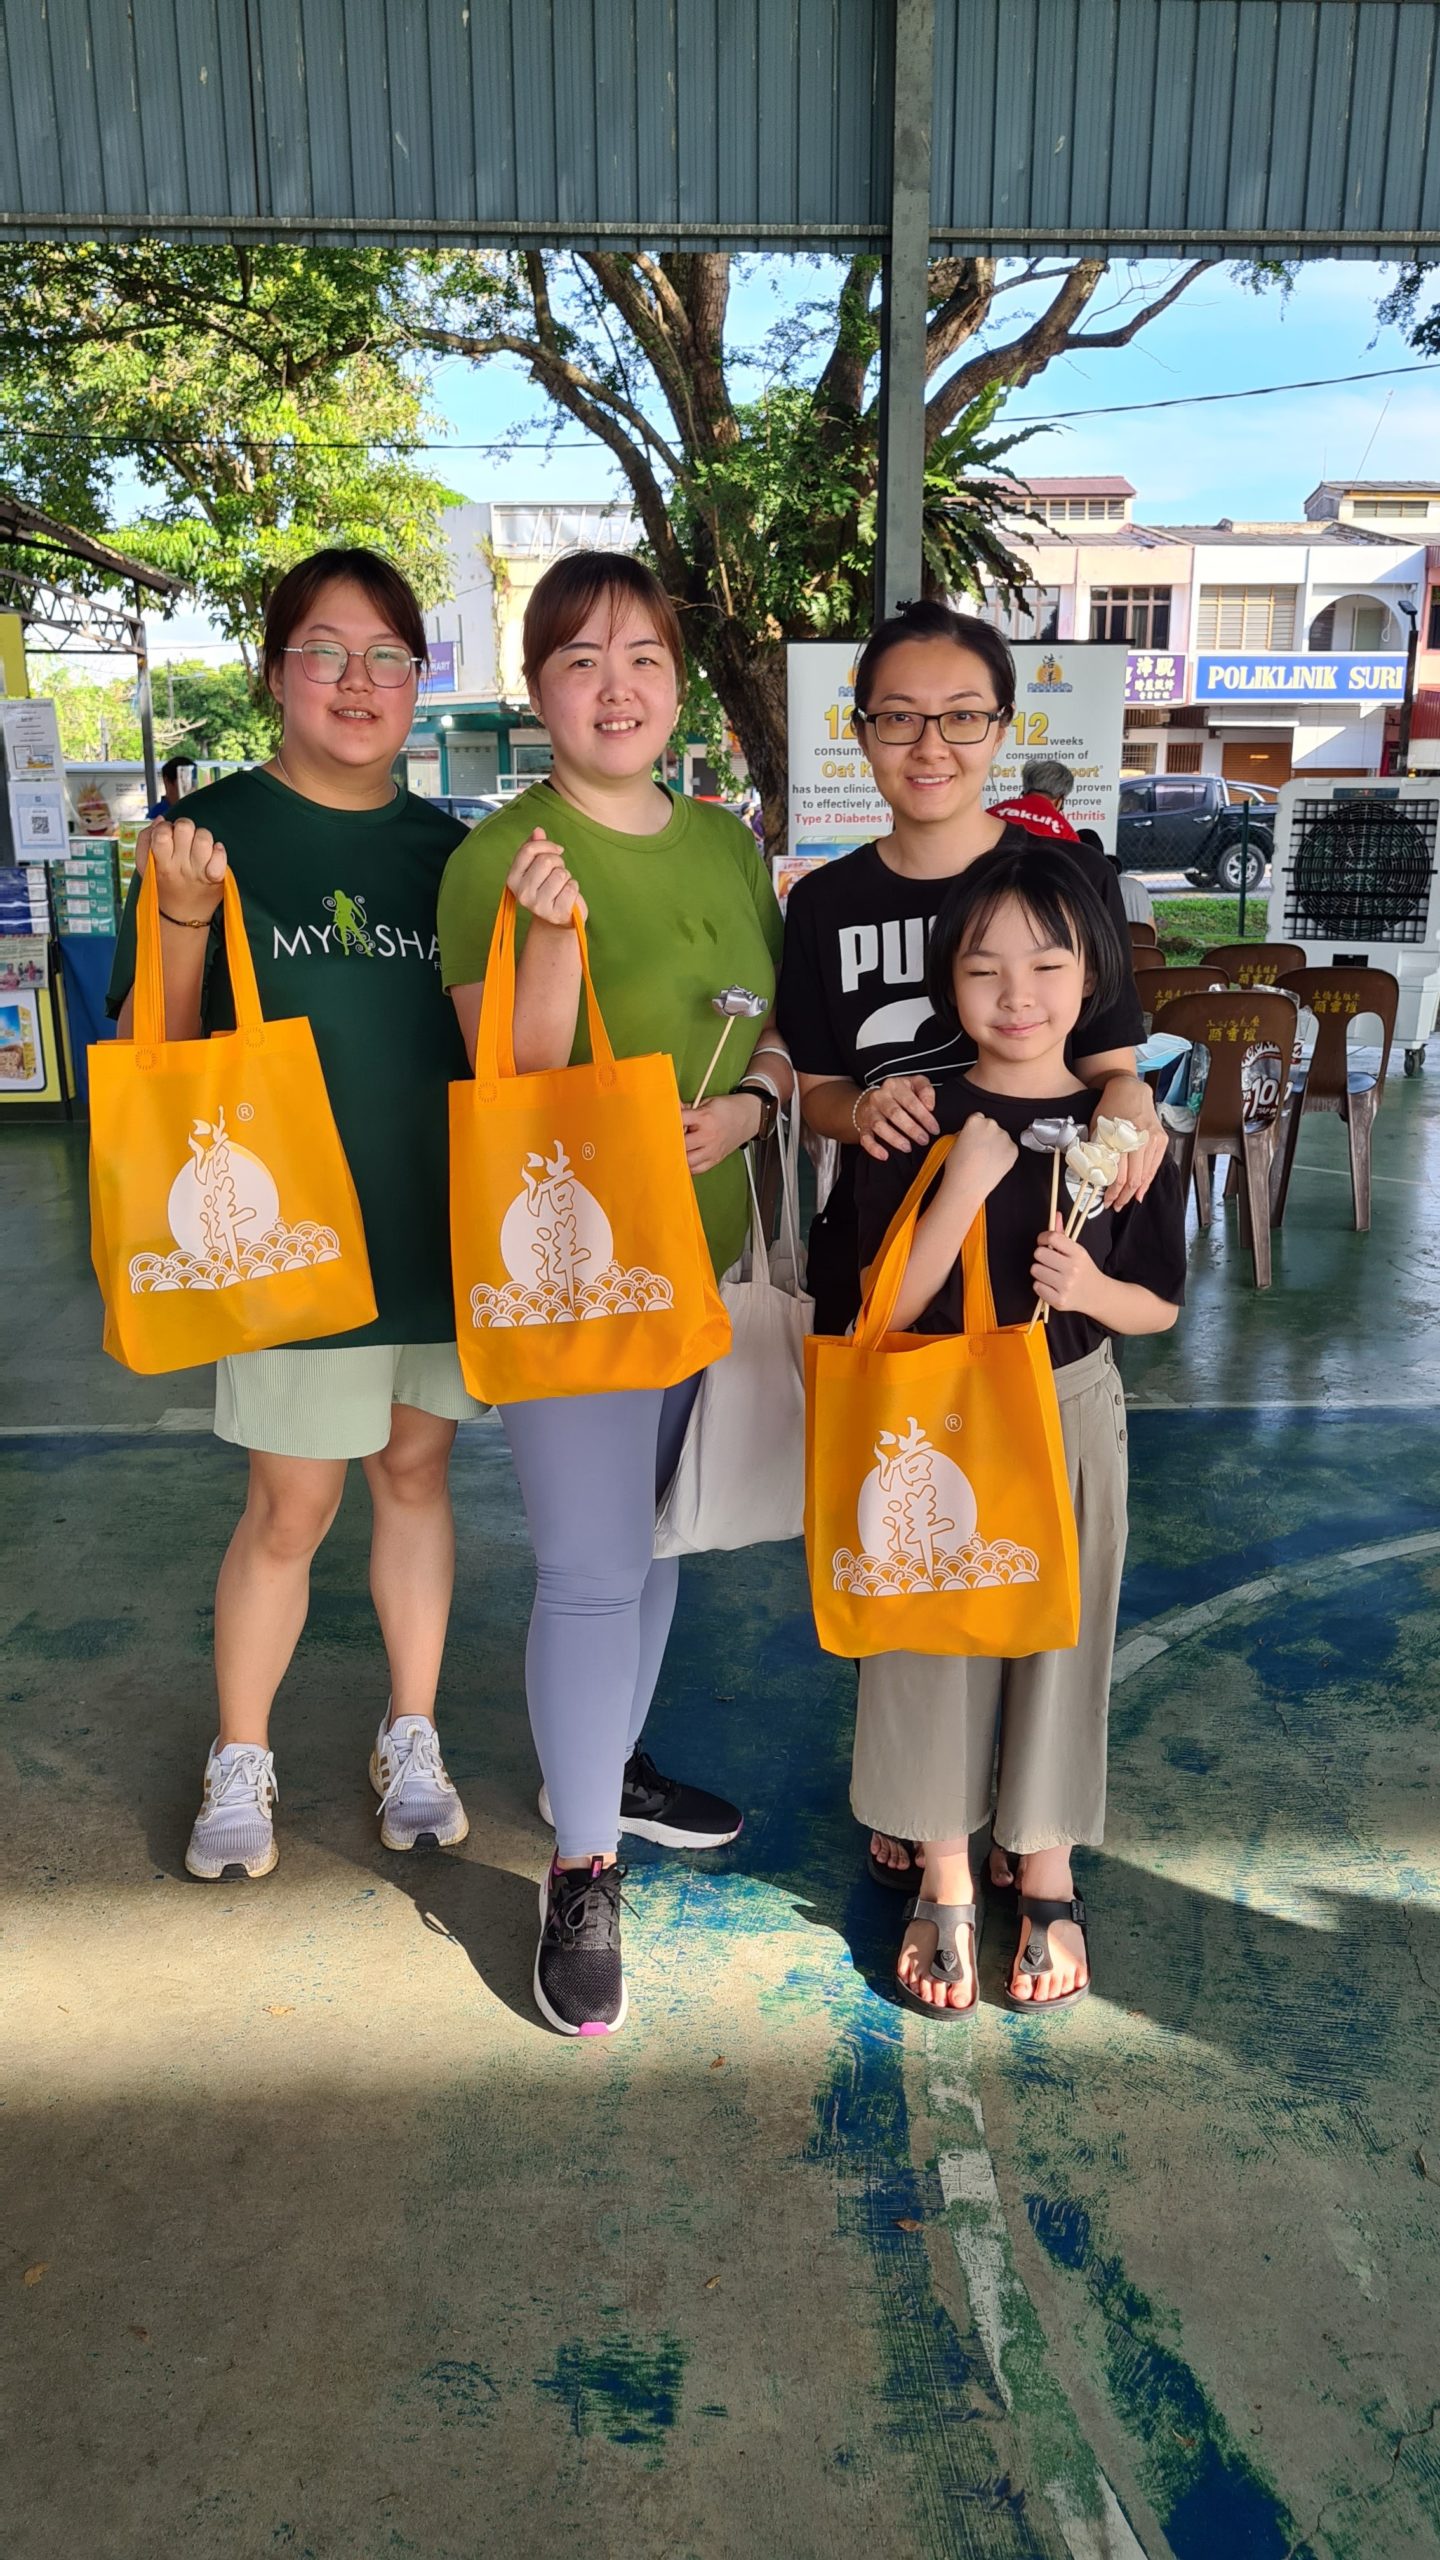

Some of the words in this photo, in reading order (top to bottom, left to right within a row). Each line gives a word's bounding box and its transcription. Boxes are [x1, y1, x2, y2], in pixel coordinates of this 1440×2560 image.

[1207, 665, 1339, 690] POLIKLINIK
[1011, 712, 1049, 745] 12
[1050, 737, 1084, 746] weeks
[1006, 750, 1075, 760] consumption
[1077, 750, 1089, 760] of
[822, 761, 855, 778] Oat
[792, 784, 811, 793] has
[814, 784, 840, 794] been
[843, 784, 880, 793] clinica
[1076, 784, 1112, 794] proven
[803, 800, 814, 808] to
[817, 799, 871, 810] effectively
[795, 813, 822, 825] Type
[825, 814, 832, 823] 2
[834, 812, 882, 823] Diabetes
[1066, 810, 1106, 821] rthritis
[273, 924, 332, 960] MY
[838, 914, 938, 994] PU
